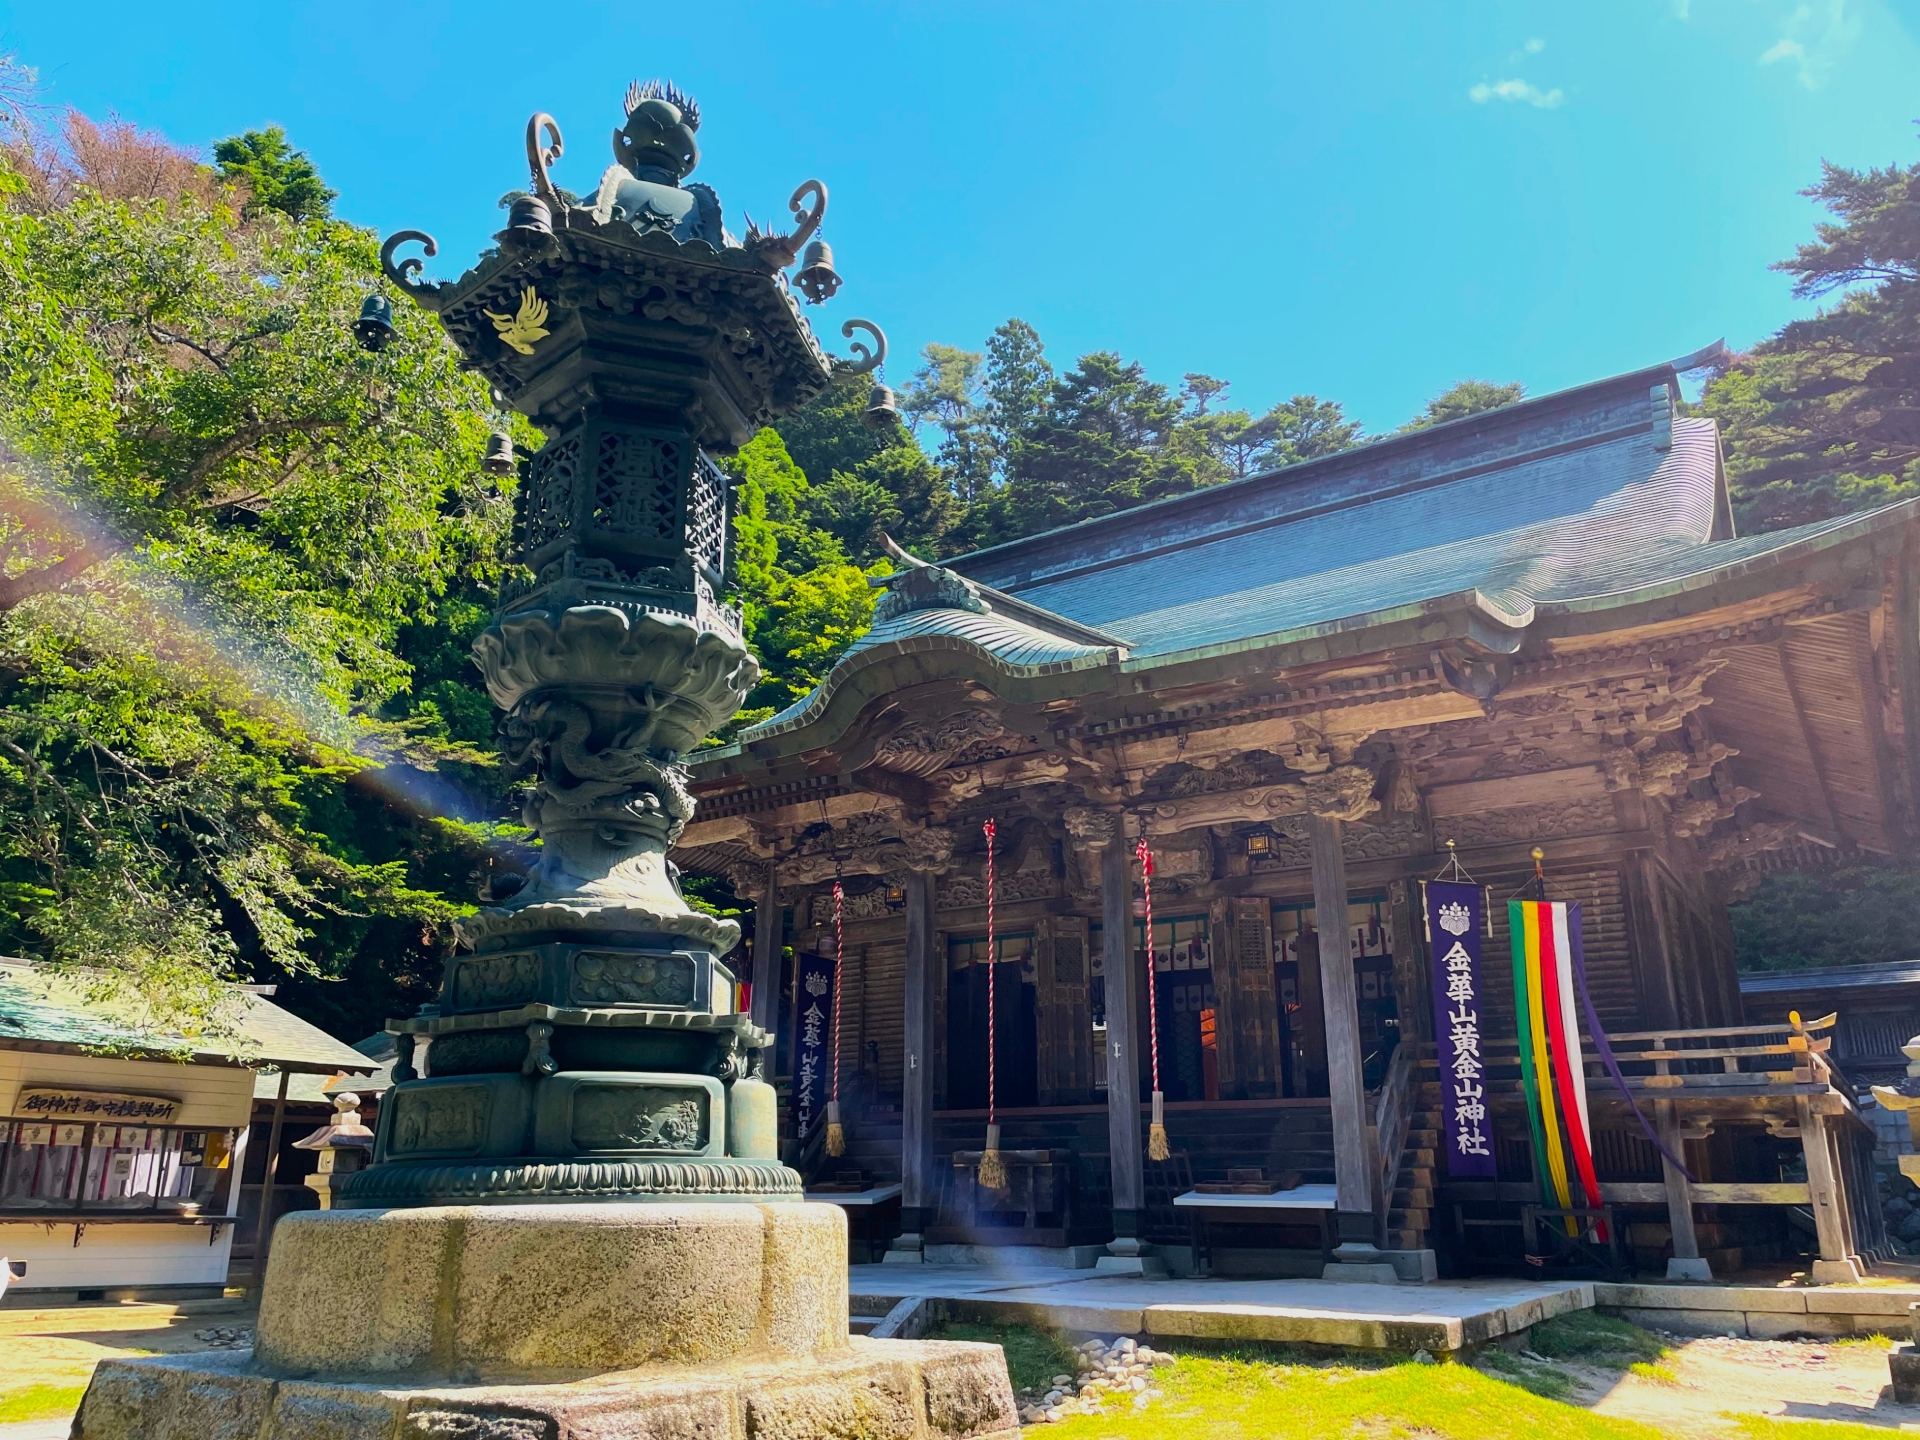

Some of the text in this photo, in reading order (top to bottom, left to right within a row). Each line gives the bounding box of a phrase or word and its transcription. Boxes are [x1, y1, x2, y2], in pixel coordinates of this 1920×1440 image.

[1441, 941, 1490, 1156] 金華山黄金山神社
